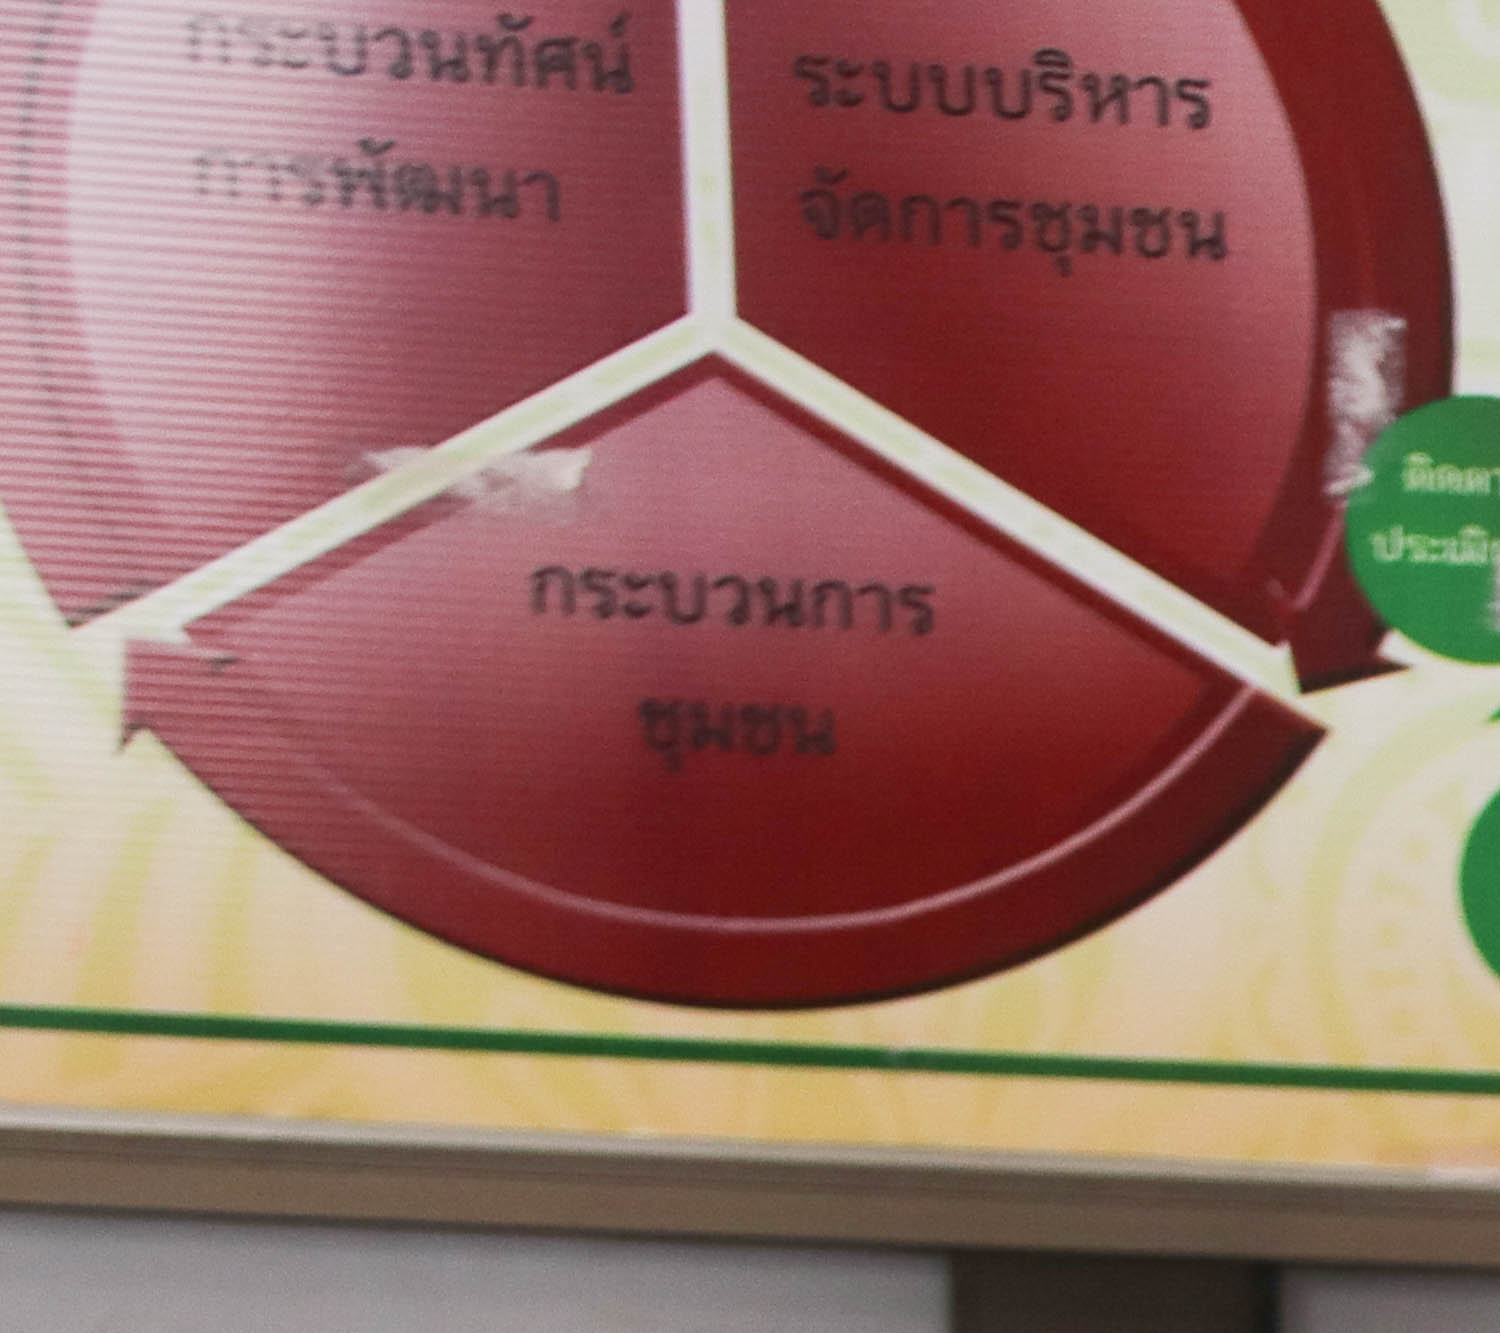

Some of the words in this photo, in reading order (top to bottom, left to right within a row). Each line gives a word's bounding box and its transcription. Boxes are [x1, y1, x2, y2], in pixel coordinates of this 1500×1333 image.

[184, 12, 636, 95] กระบวนทัศน์
[794, 47, 1214, 130] ระบบบริหาร
[194, 137, 562, 222] การพัฒนา
[799, 166, 1228, 276] จัดการชุมชน
[530, 565, 936, 637] กระบวนการ
[637, 697, 837, 773] ชุมชน
